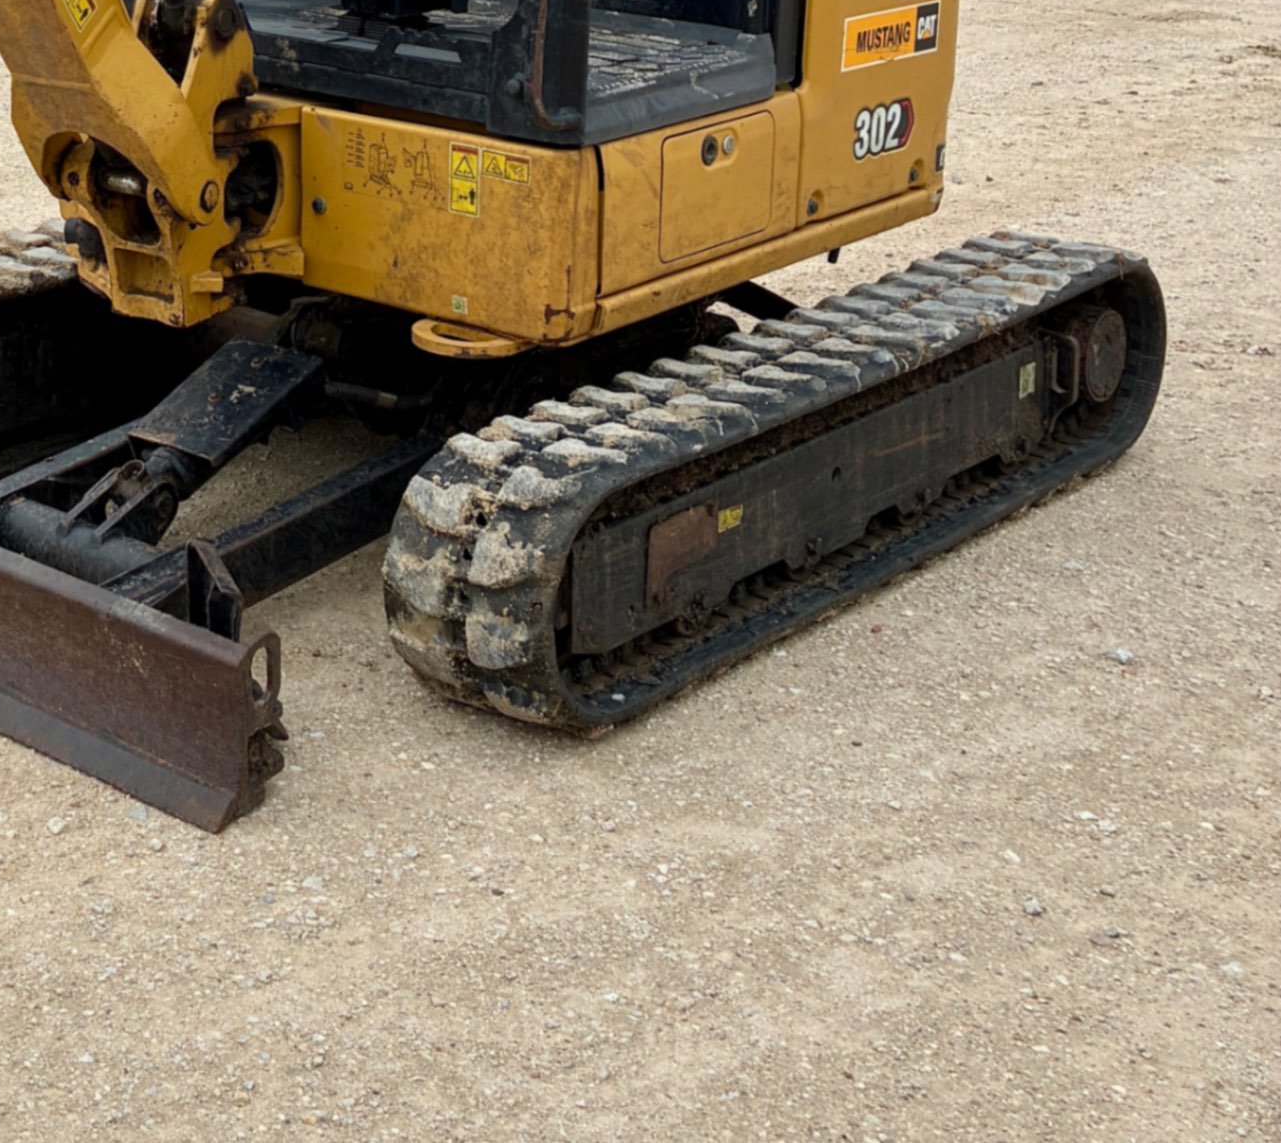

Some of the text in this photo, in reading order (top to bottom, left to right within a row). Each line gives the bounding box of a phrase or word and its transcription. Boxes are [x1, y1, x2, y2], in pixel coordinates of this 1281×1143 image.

[856, 14, 937, 53] MUSTANG CAT
[855, 102, 902, 158] 302
